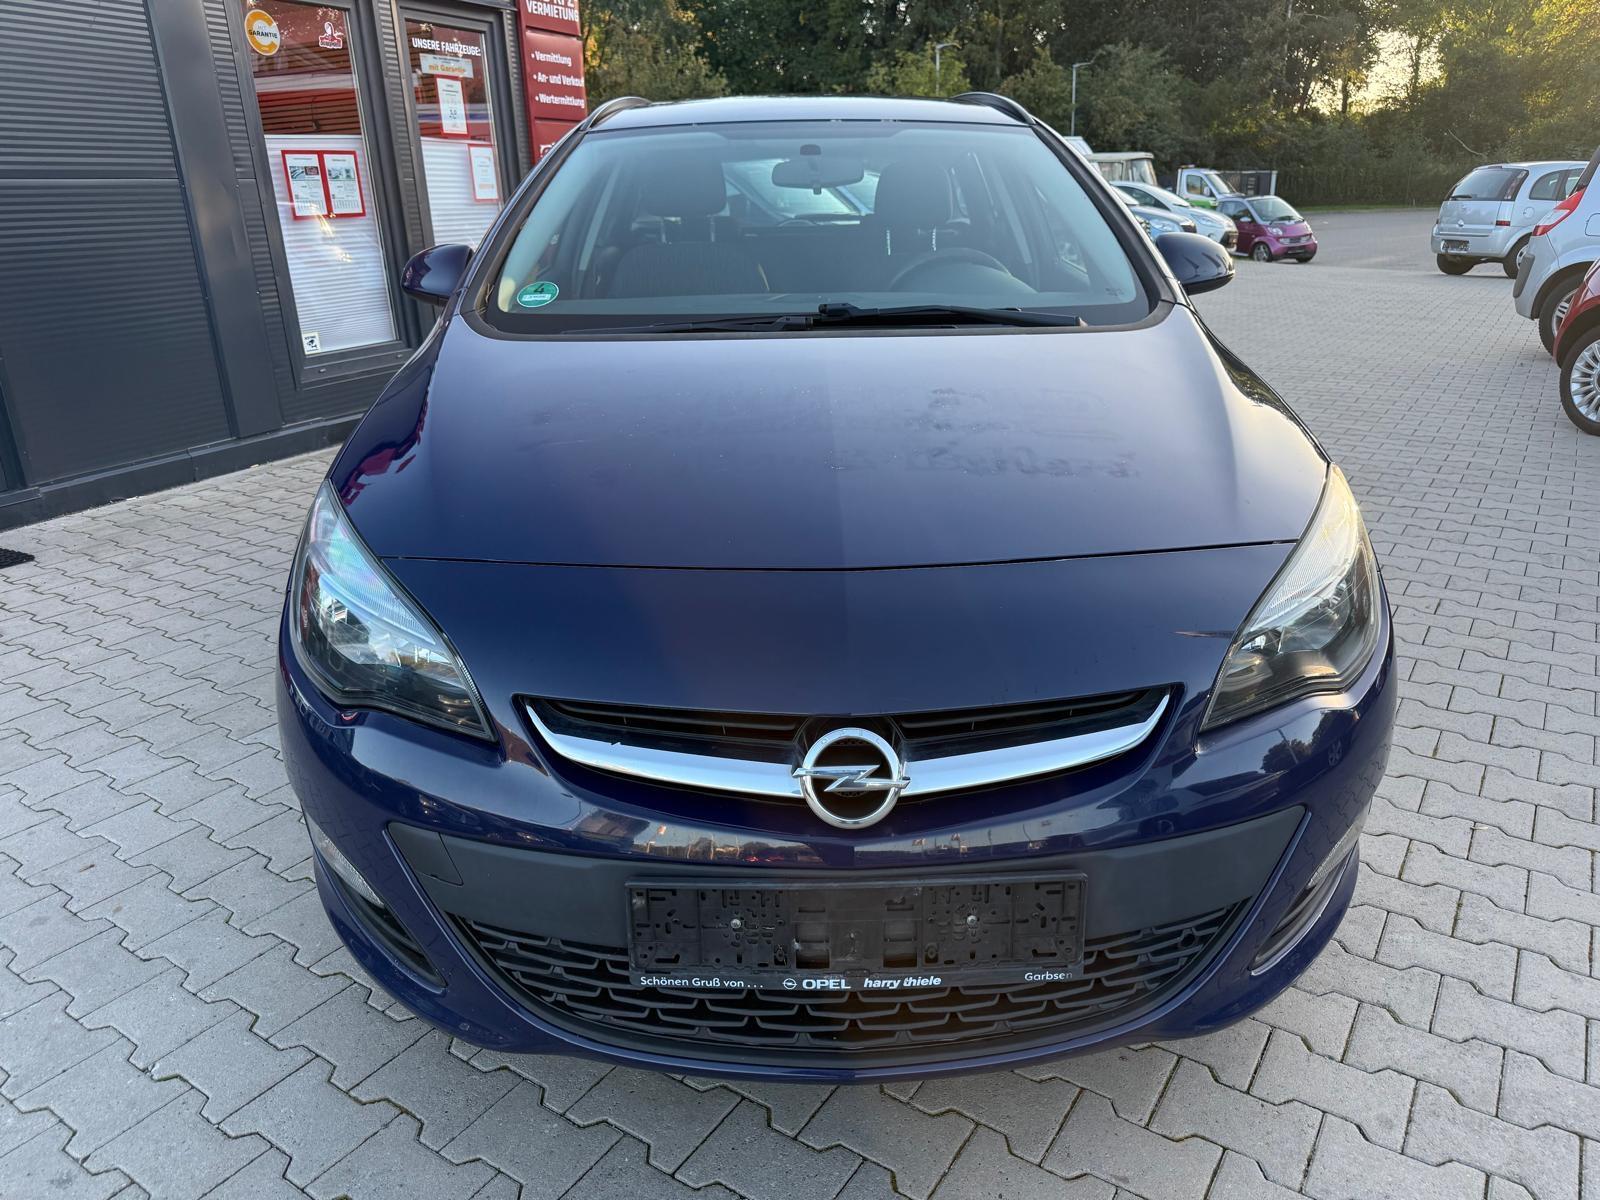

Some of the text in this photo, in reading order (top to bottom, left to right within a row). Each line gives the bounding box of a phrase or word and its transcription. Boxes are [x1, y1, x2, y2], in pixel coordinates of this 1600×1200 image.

[525, 1, 579, 22] VERMIETUNG
[248, 29, 278, 39] GARANTIE
[411, 37, 482, 57] UNSERE FAHRZEUGE:
[534, 51, 572, 67] Vermittlung
[549, 74, 561, 85] und
[538, 93, 585, 109] Wertermittlung
[640, 976, 689, 986] Schönen
[692, 977, 721, 987] Gruß
[723, 979, 744, 988] von
[802, 978, 851, 990] OPEL
[863, 977, 901, 989] harry
[903, 976, 942, 987] thiele
[1024, 970, 1073, 981] Garbsen
